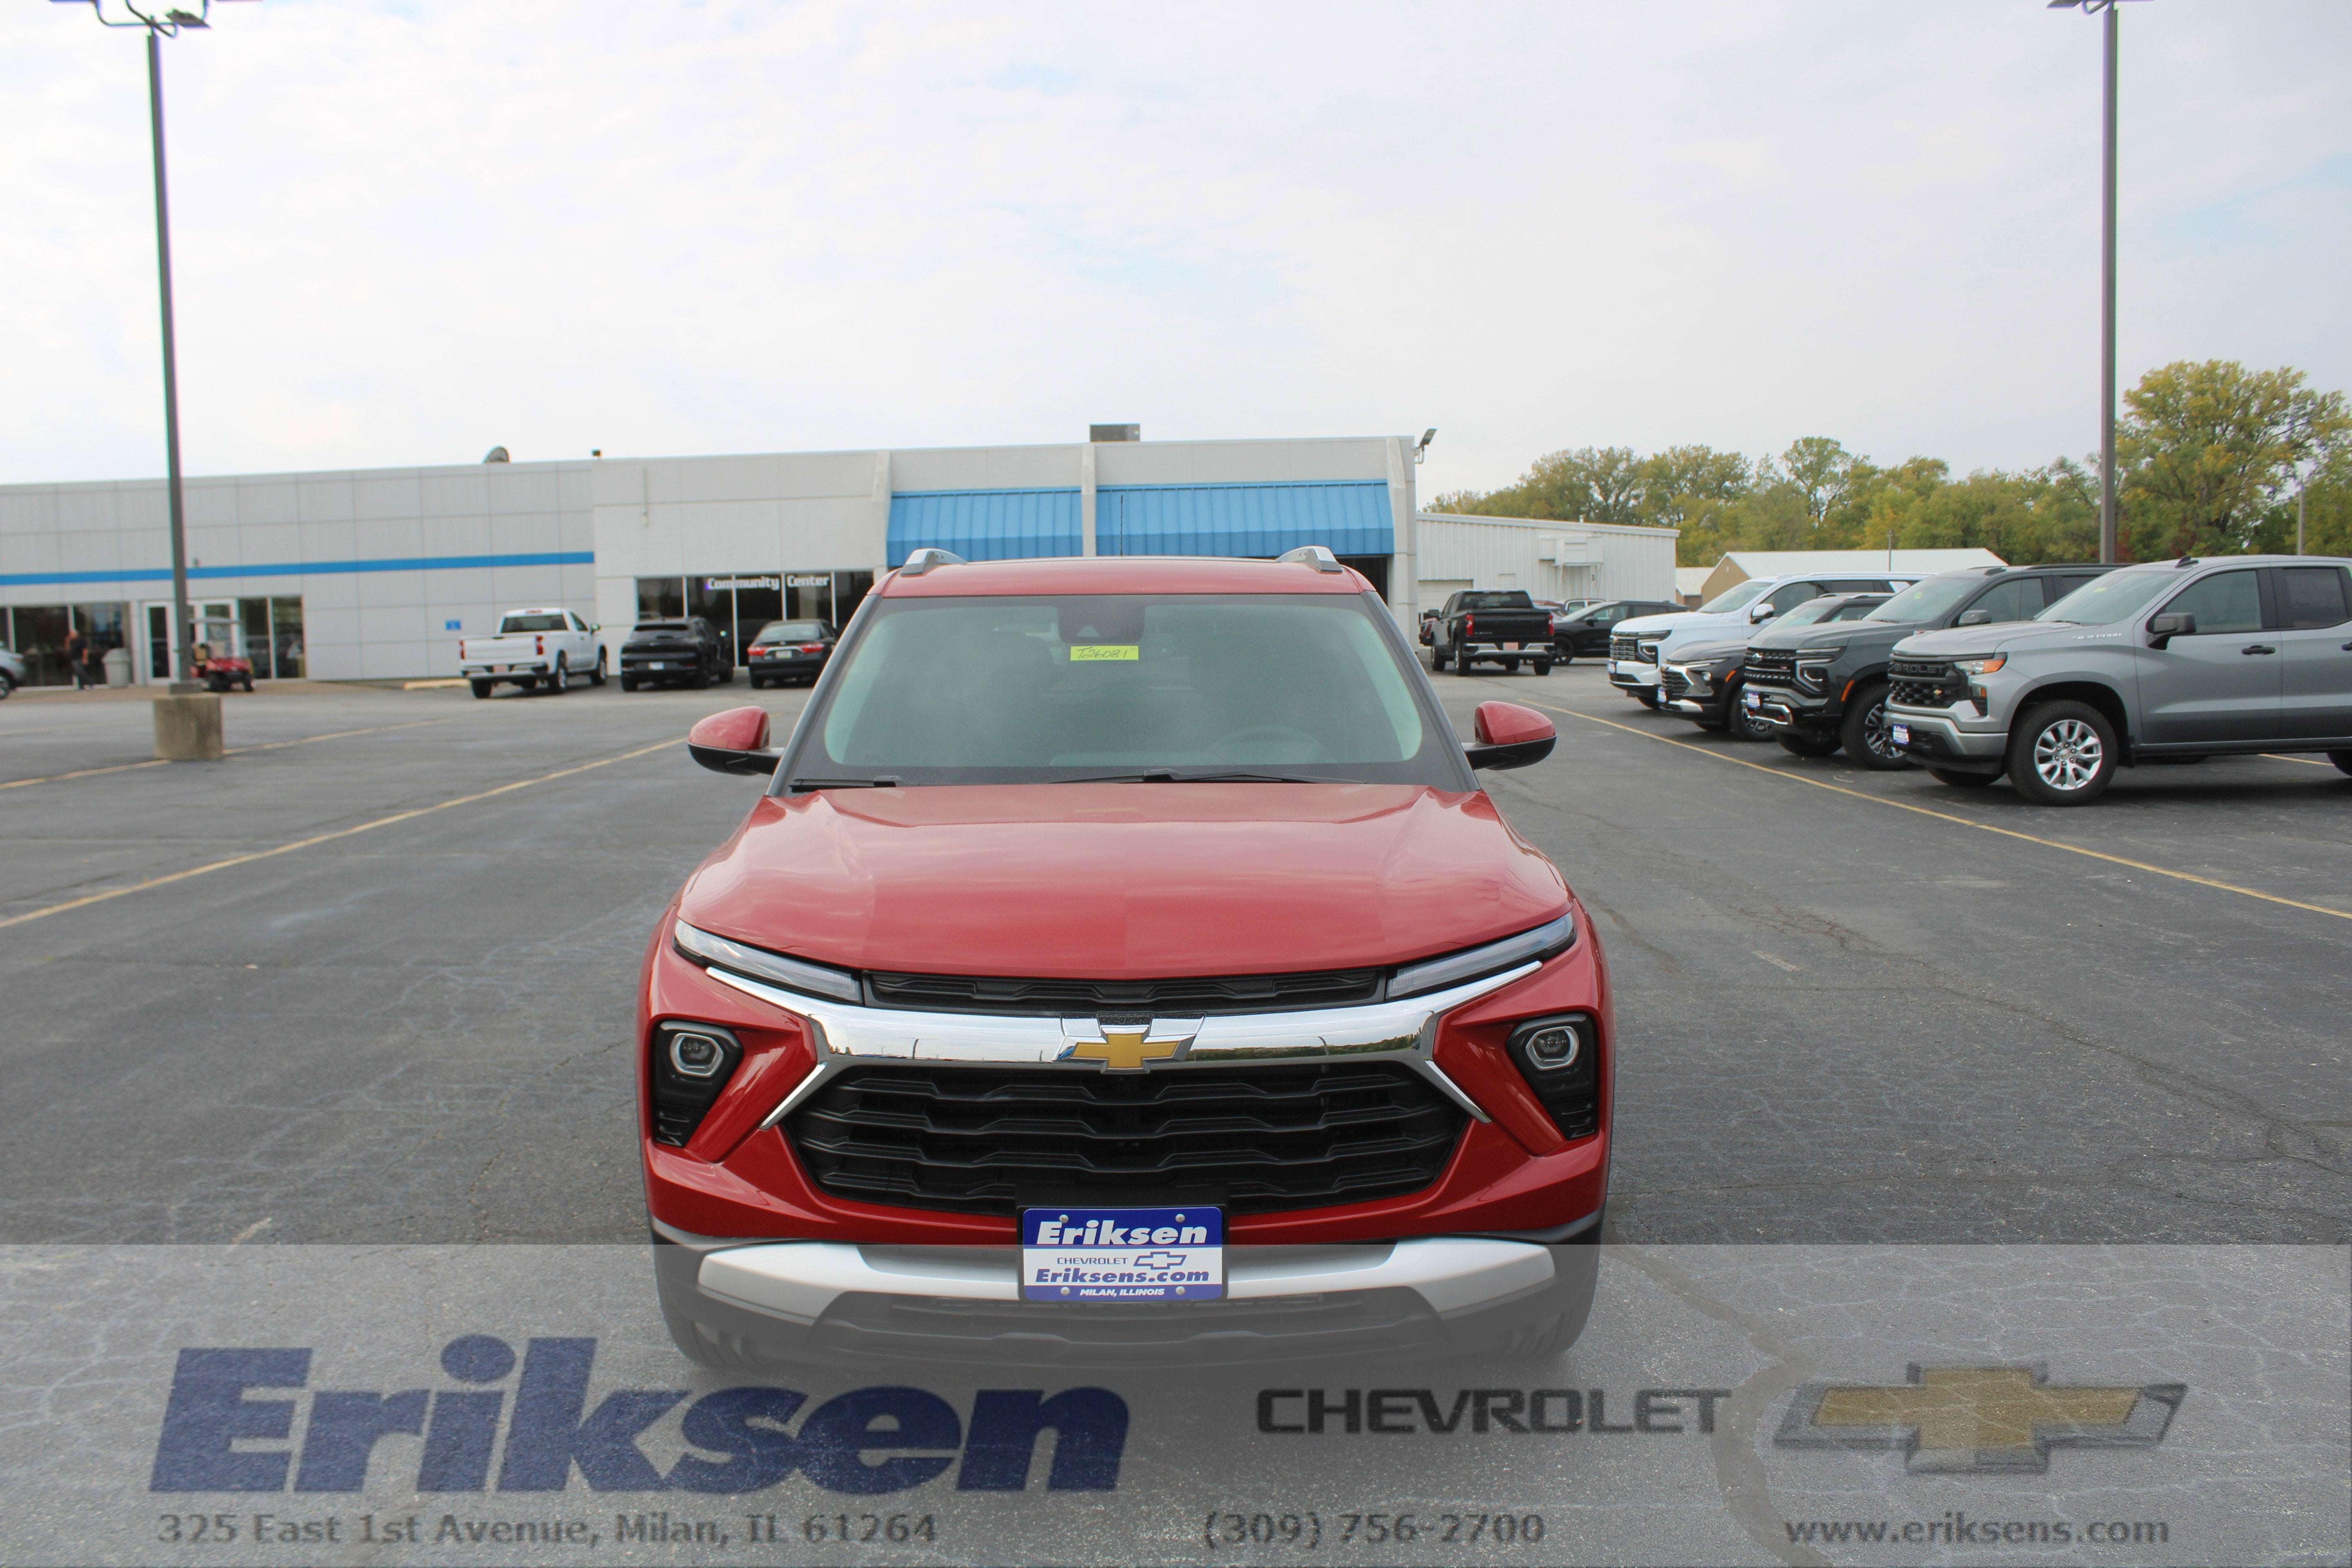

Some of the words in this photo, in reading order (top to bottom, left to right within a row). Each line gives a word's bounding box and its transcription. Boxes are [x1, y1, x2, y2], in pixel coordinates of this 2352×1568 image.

[708, 576, 780, 590] Community
[787, 575, 830, 587] Center
[1036, 1220, 1207, 1245] Eriksen
[1036, 1268, 1209, 1283] Eriksens.com
[1080, 1288, 1117, 1297] MILAN,
